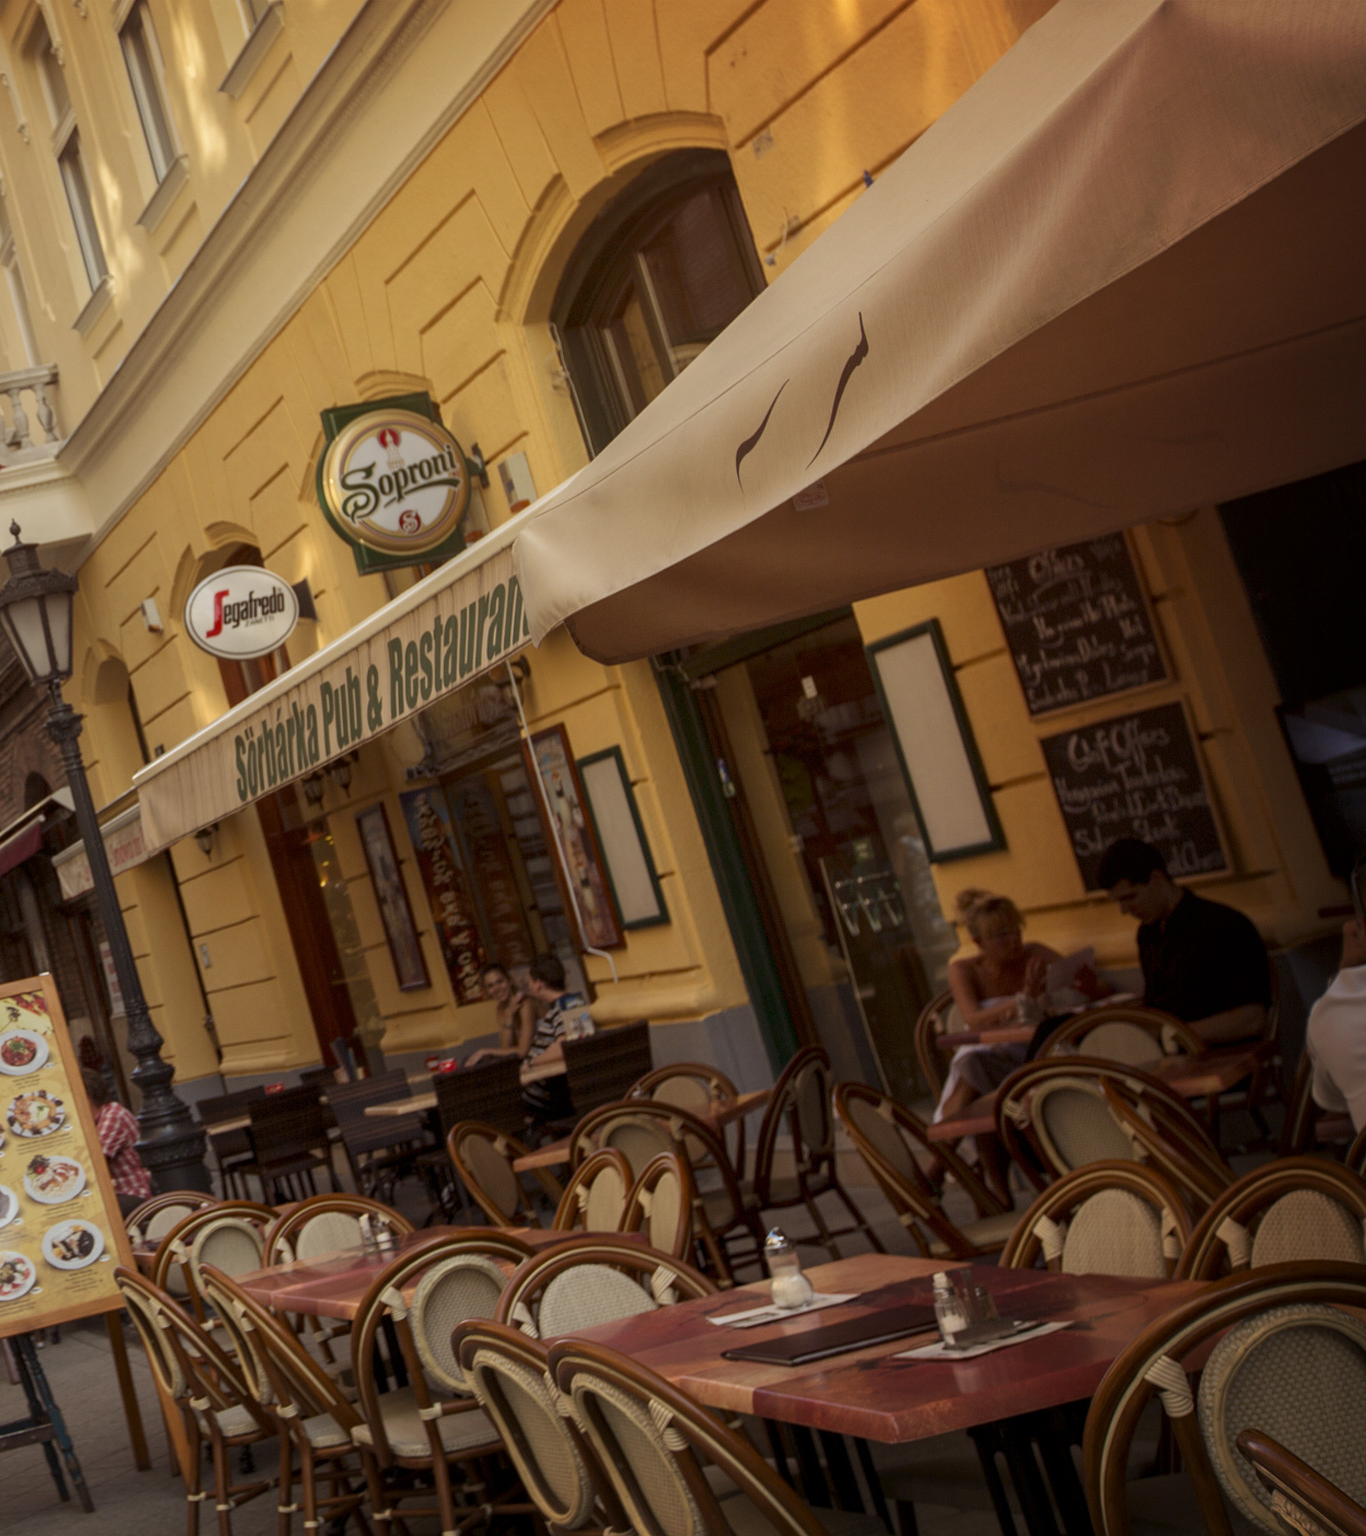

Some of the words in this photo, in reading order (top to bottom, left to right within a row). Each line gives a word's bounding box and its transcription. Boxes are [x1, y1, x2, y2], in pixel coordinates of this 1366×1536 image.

[341, 444, 457, 525] Soproni
[206, 586, 285, 639] Segafredo
[235, 701, 321, 802] Sörbárka
[320, 666, 363, 757] Pub
[366, 664, 384, 732] &
